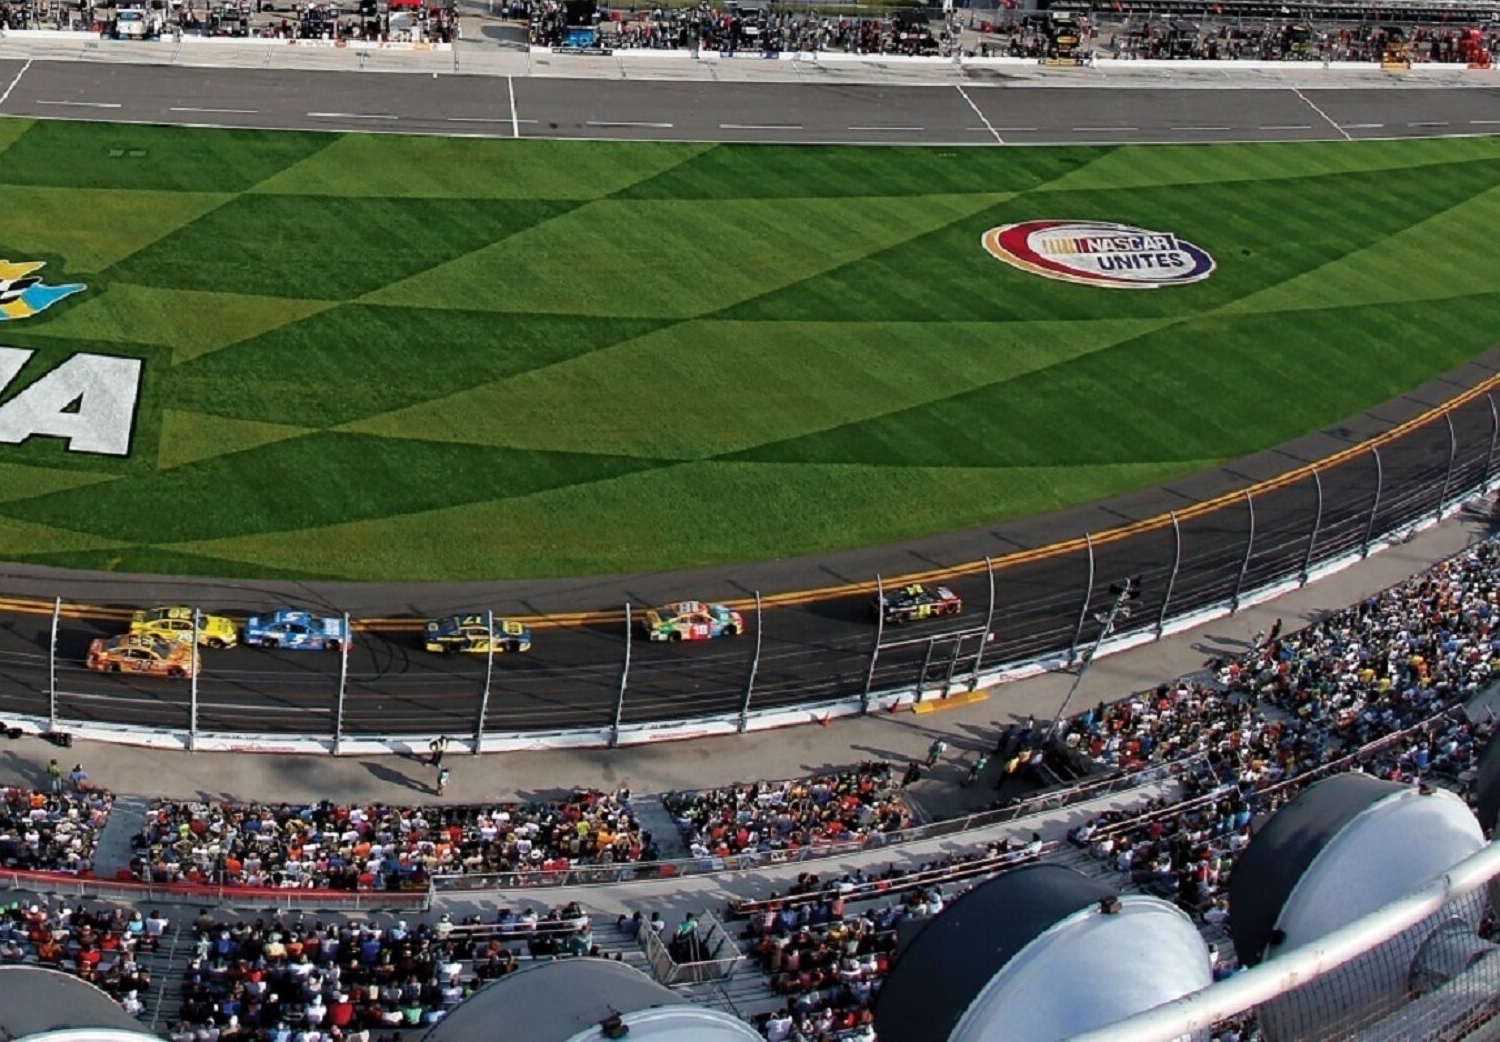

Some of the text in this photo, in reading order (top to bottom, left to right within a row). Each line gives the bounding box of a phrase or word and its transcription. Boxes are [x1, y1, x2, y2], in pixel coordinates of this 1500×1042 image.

[1087, 235, 1170, 253] NASCAR
[1099, 253, 1184, 270] UNITES
[693, 624, 708, 635] 18
[289, 633, 308, 645] 5
